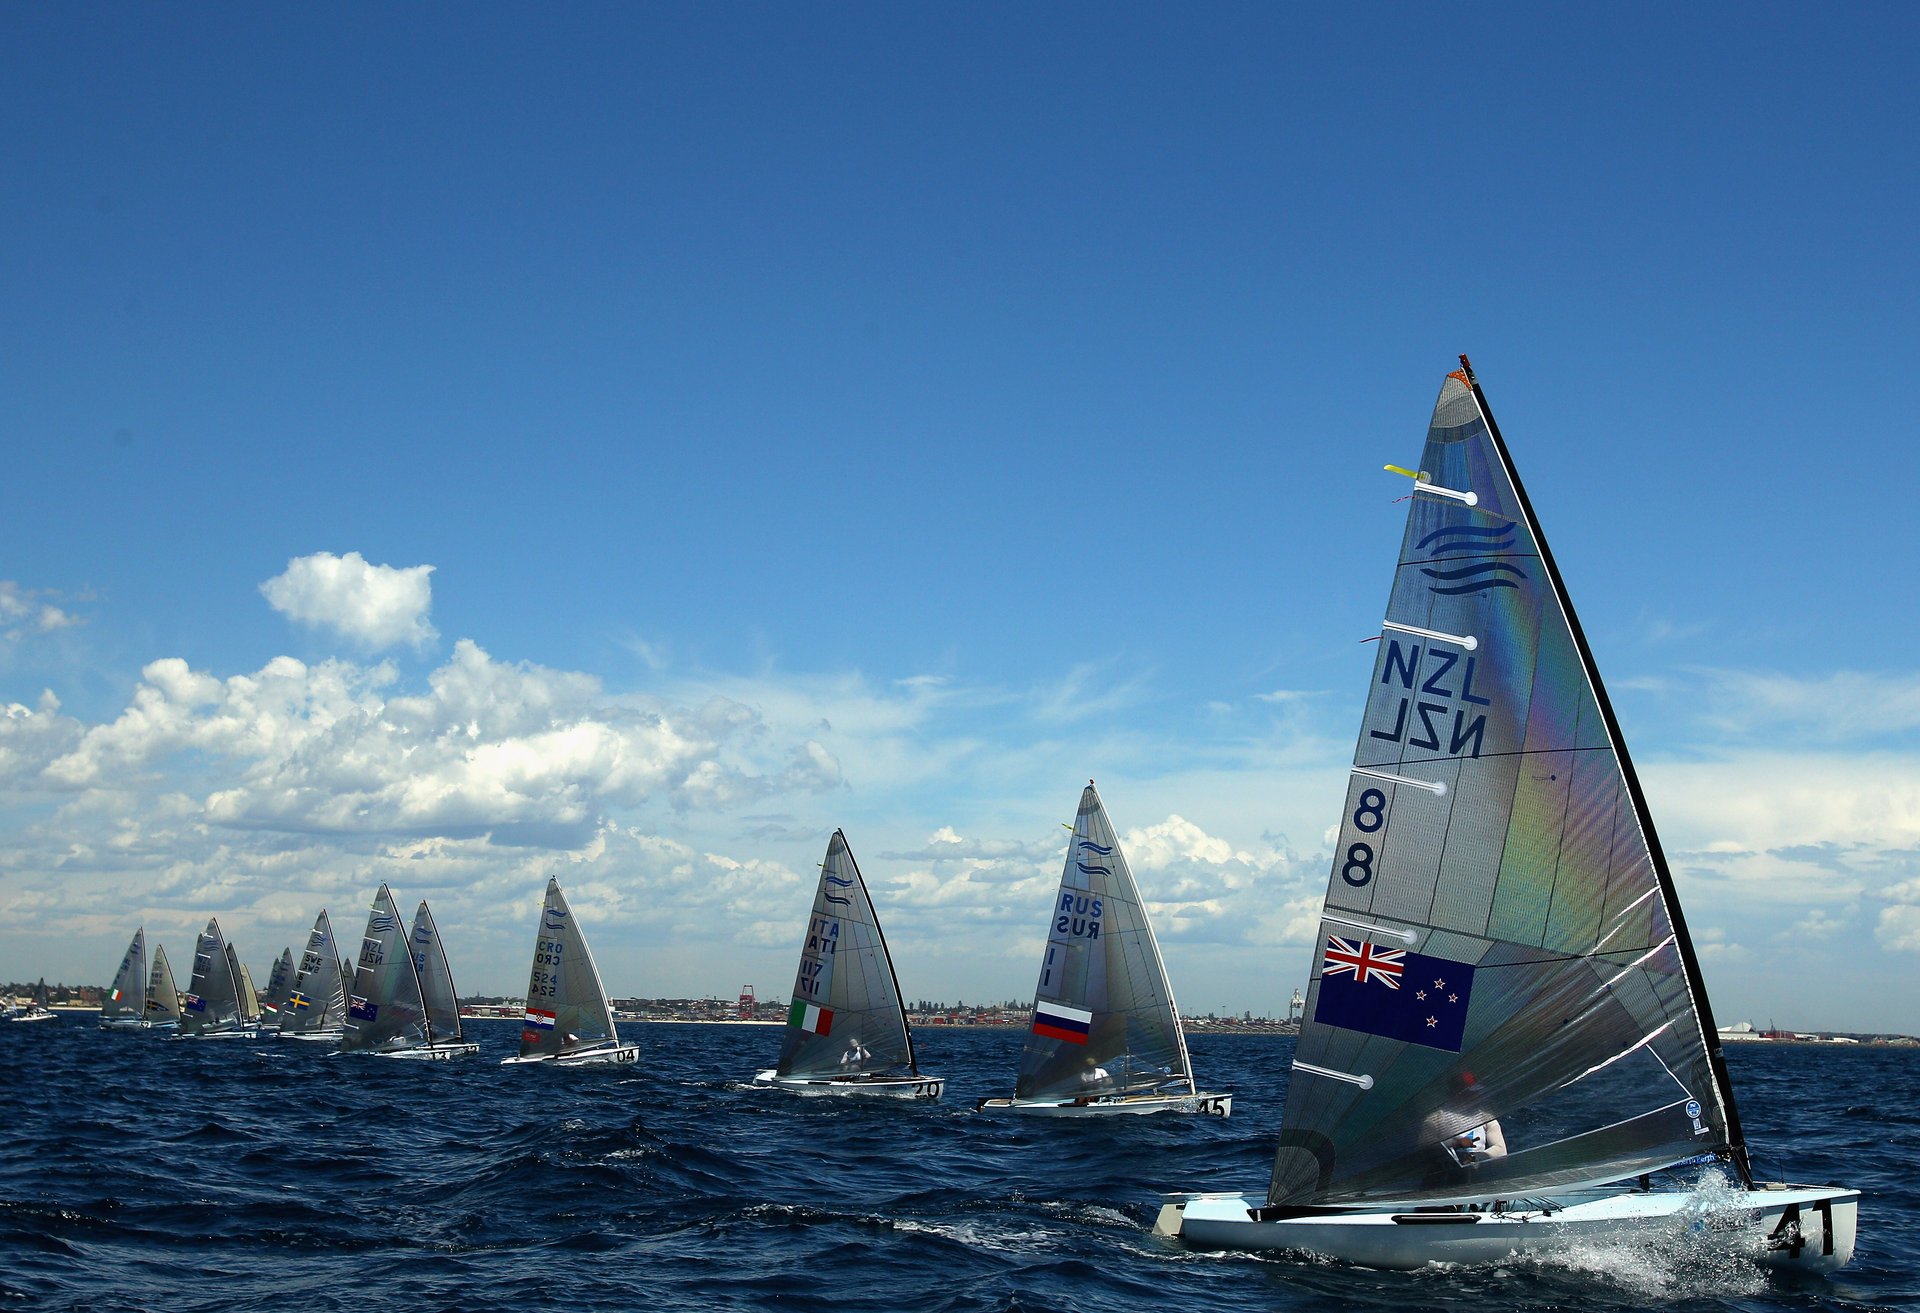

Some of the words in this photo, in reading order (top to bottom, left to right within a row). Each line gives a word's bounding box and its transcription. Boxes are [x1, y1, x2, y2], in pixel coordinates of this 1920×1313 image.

[1382, 640, 1490, 706] NZL
[1353, 788, 1386, 833] 8
[1342, 842, 1374, 887] 8
[1060, 893, 1103, 918] RUS
[811, 918, 840, 938] ITA
[363, 940, 384, 955] NZL
[538, 941, 563, 953] CRO
[305, 954, 323, 966] SWE
[802, 960, 823, 977] 117
[533, 972, 557, 985] 524
[617, 1049, 635, 1063] 04
[911, 1081, 940, 1099] 20
[1198, 1097, 1225, 1116] 45
[1767, 1198, 1834, 1259] 41
